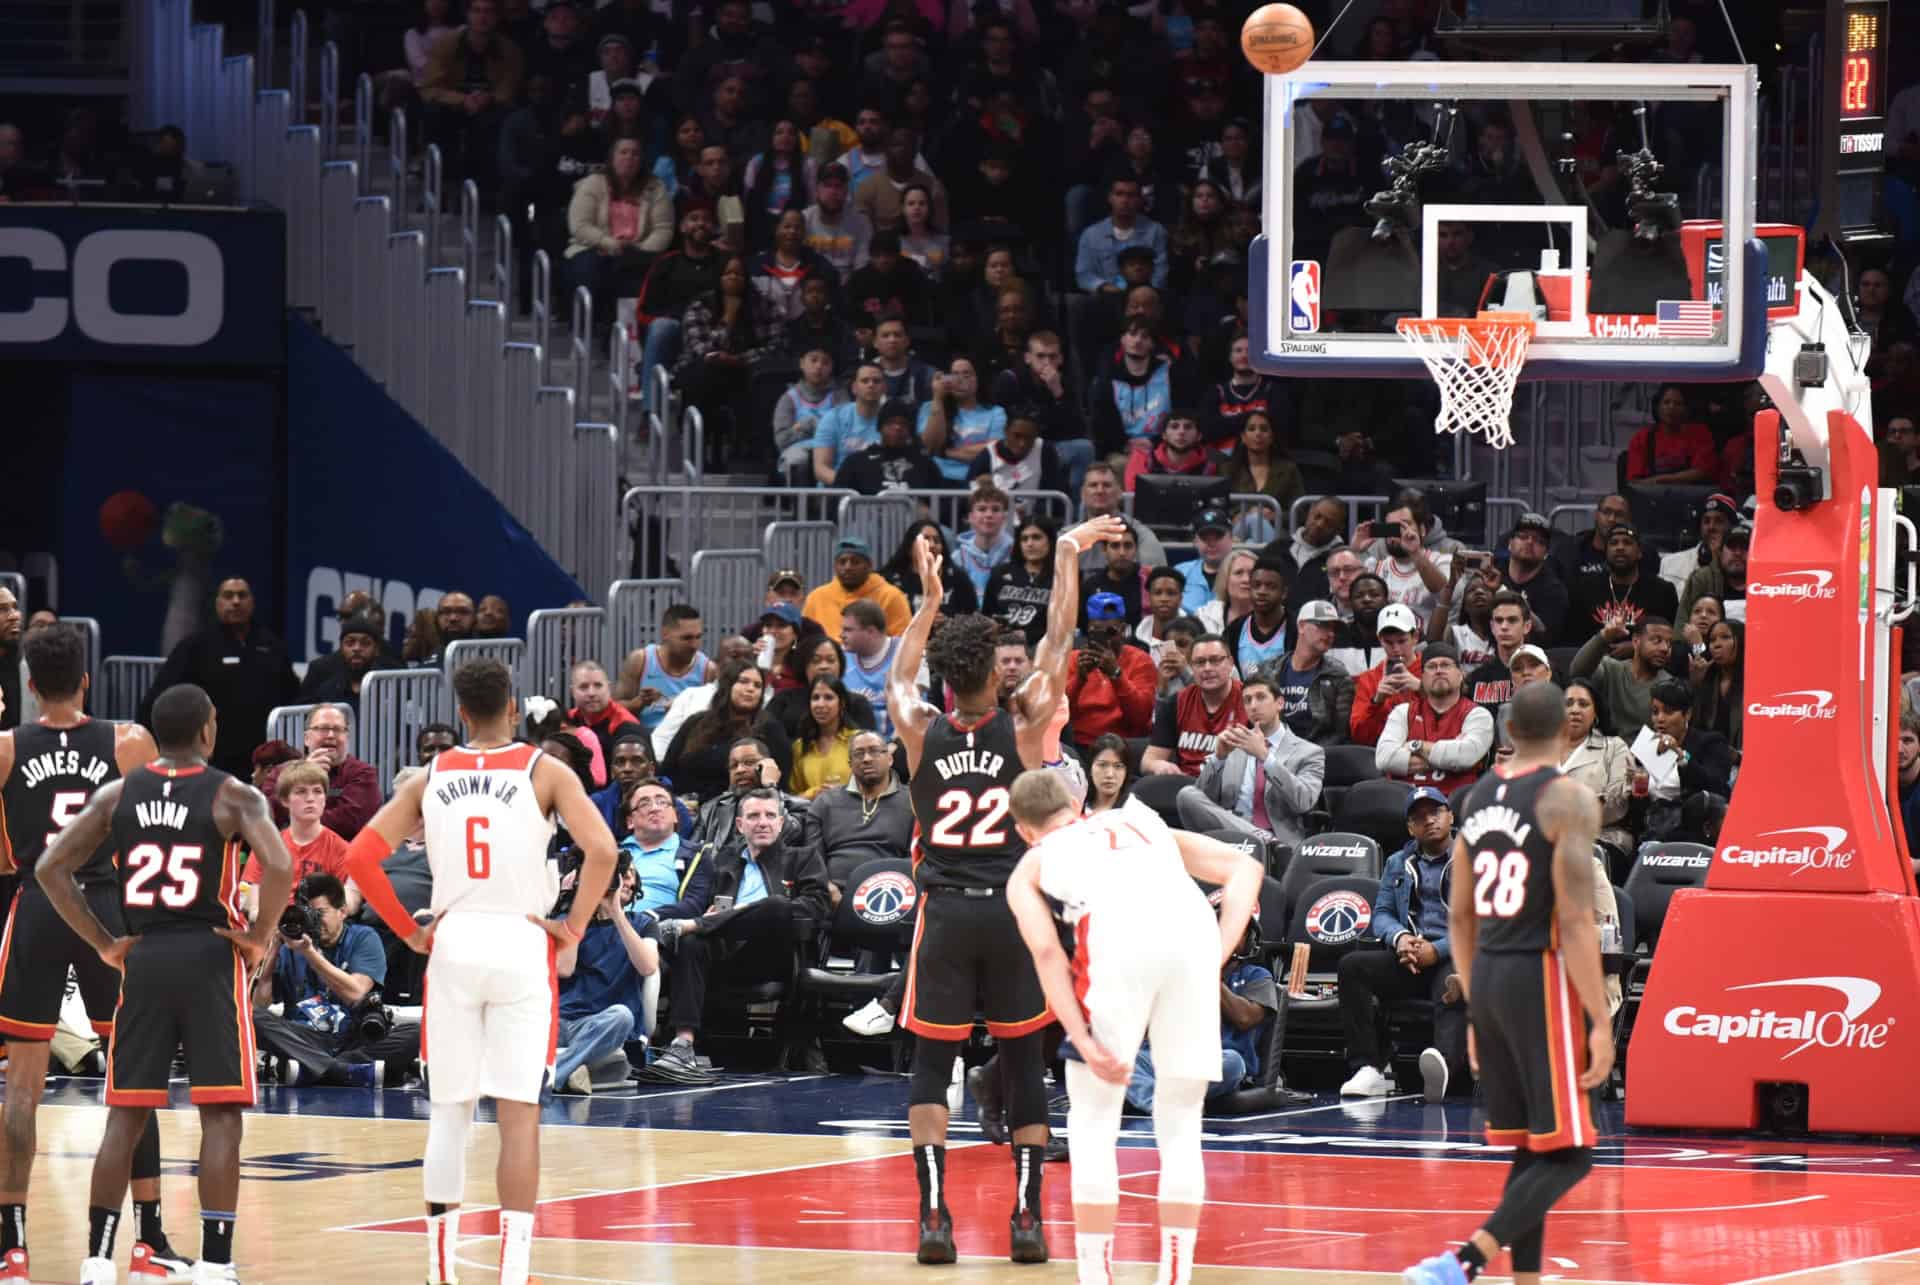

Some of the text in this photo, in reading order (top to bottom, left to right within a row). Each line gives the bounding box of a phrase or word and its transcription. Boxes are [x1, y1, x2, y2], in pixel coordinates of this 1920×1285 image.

[1845, 58, 1869, 110] 22
[1281, 343, 1327, 354] SPALDING
[21, 750, 109, 788] JONES JR
[934, 750, 1005, 780] BUTLER
[437, 775, 493, 807] BROWN
[45, 791, 87, 848] 5
[135, 800, 189, 830] NUNN
[930, 786, 1011, 847] 22
[466, 816, 491, 880] 6
[1302, 841, 1369, 858] wizards
[1642, 851, 1712, 868] wizards
[124, 842, 203, 908] 25
[1473, 849, 1530, 918] 28
